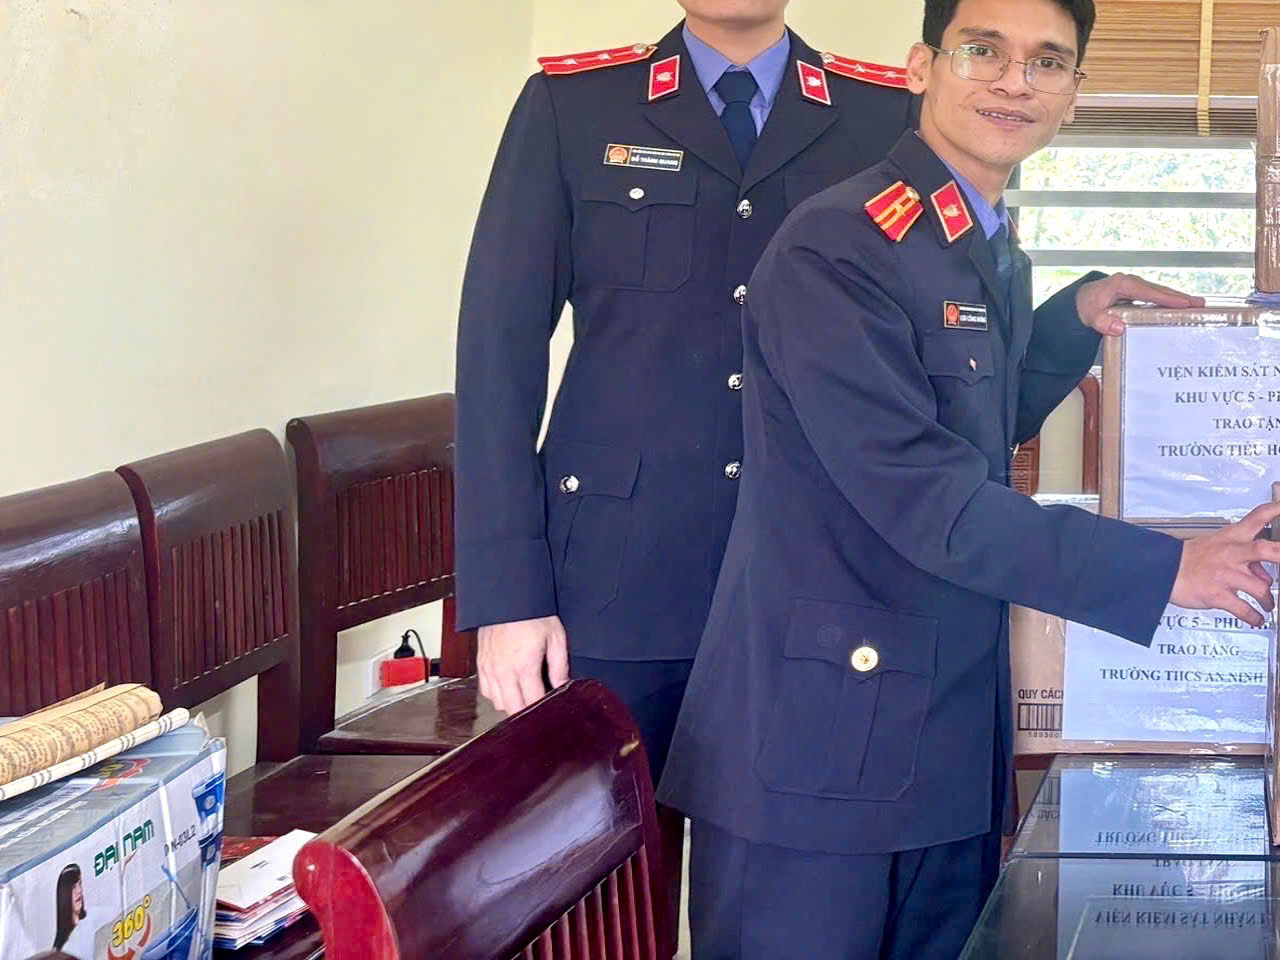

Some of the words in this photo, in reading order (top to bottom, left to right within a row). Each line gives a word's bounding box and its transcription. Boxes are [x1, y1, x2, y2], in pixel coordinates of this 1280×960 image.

[1157, 366, 1194, 380] VIỆN
[1197, 363, 1238, 378] KIỂM
[1241, 363, 1270, 377] SÁT
[1175, 392, 1208, 404] KHU
[1211, 391, 1245, 406] VỰC
[1248, 391, 1256, 403] 5
[1213, 417, 1252, 430] TRAO
[1158, 442, 1224, 457] TRƯỜNG
[1191, 617, 1200, 628] 5
[1158, 644, 1197, 656] TRAO
[1201, 644, 1240, 659] TẶNG
[1100, 666, 1161, 682] TRƯỜNG
[1164, 670, 1202, 682] THCS
[1205, 672, 1226, 683] AN
[1018, 688, 1038, 700] QUY
